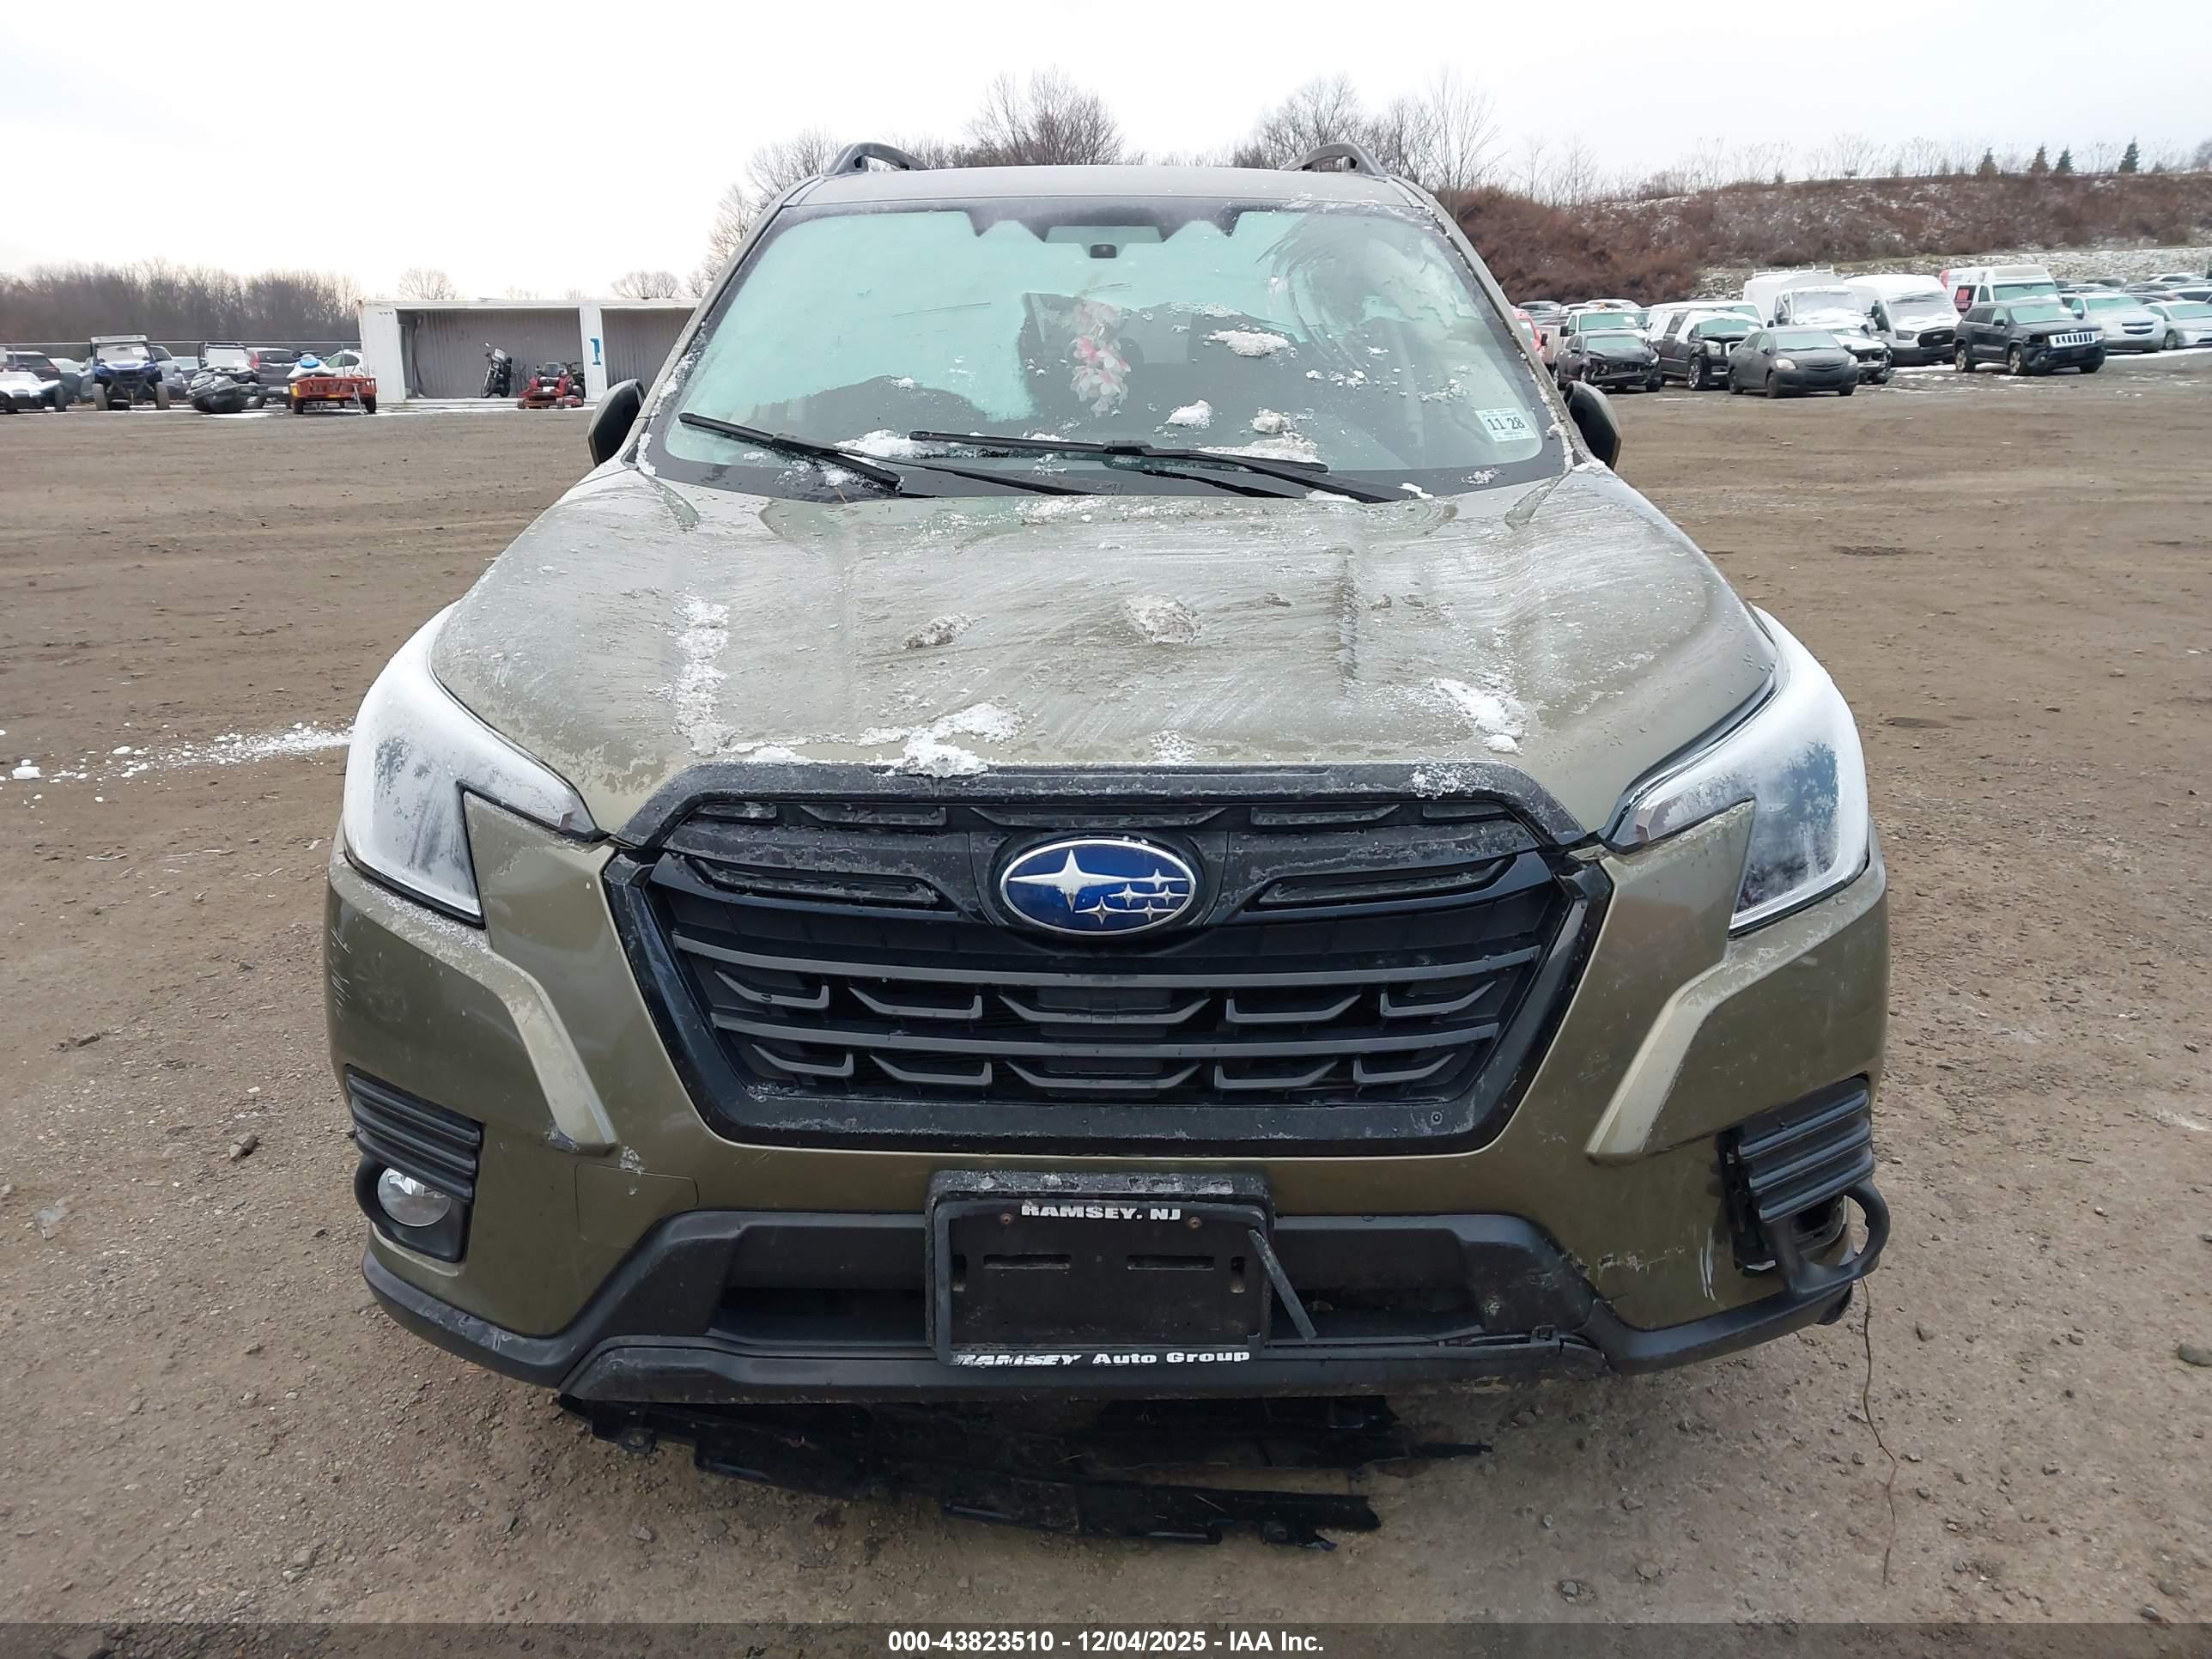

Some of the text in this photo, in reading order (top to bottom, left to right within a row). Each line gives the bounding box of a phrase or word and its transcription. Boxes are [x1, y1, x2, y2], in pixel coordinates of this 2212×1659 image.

[590, 337, 601, 366] 1
[1487, 416, 1526, 430] 11 28
[1150, 1208, 1181, 1220] NJ
[1092, 1352, 1157, 1364] Auto
[1166, 1352, 1249, 1364] Group
